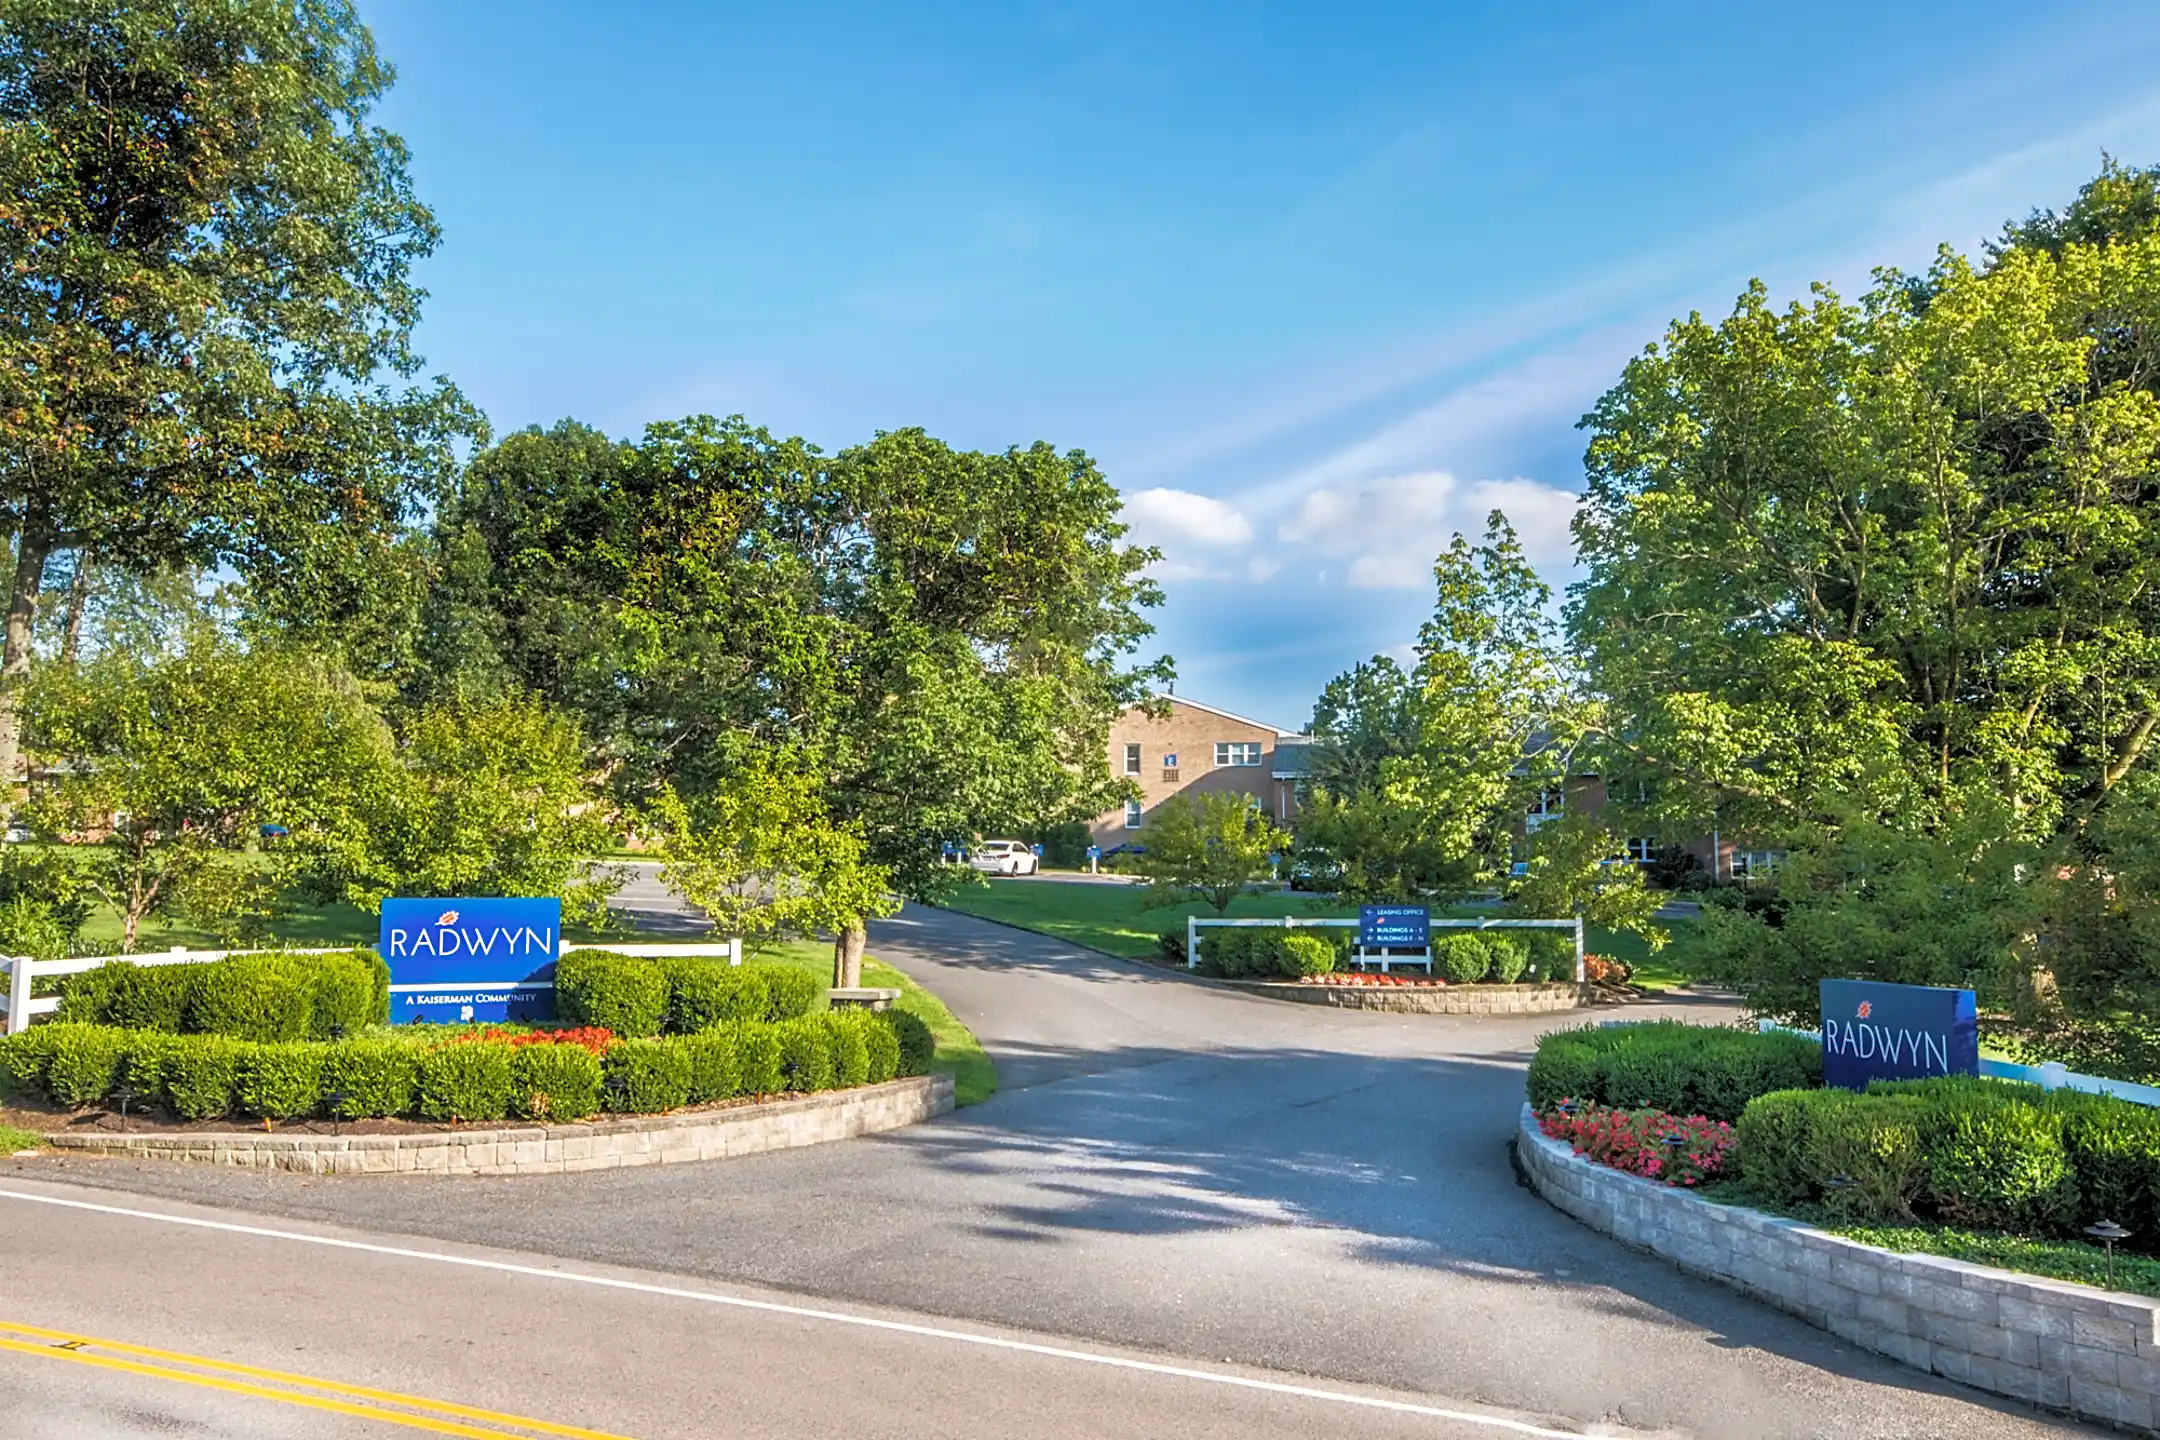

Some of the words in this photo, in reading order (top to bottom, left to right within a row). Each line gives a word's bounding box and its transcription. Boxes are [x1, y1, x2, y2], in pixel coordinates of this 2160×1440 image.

[390, 927, 551, 957] RADWYN
[405, 995, 415, 1005] A
[417, 994, 473, 1005] KAISERMAN
[475, 993, 537, 1003] COMMUNITY
[1826, 1019, 1948, 1073] RADWYN
